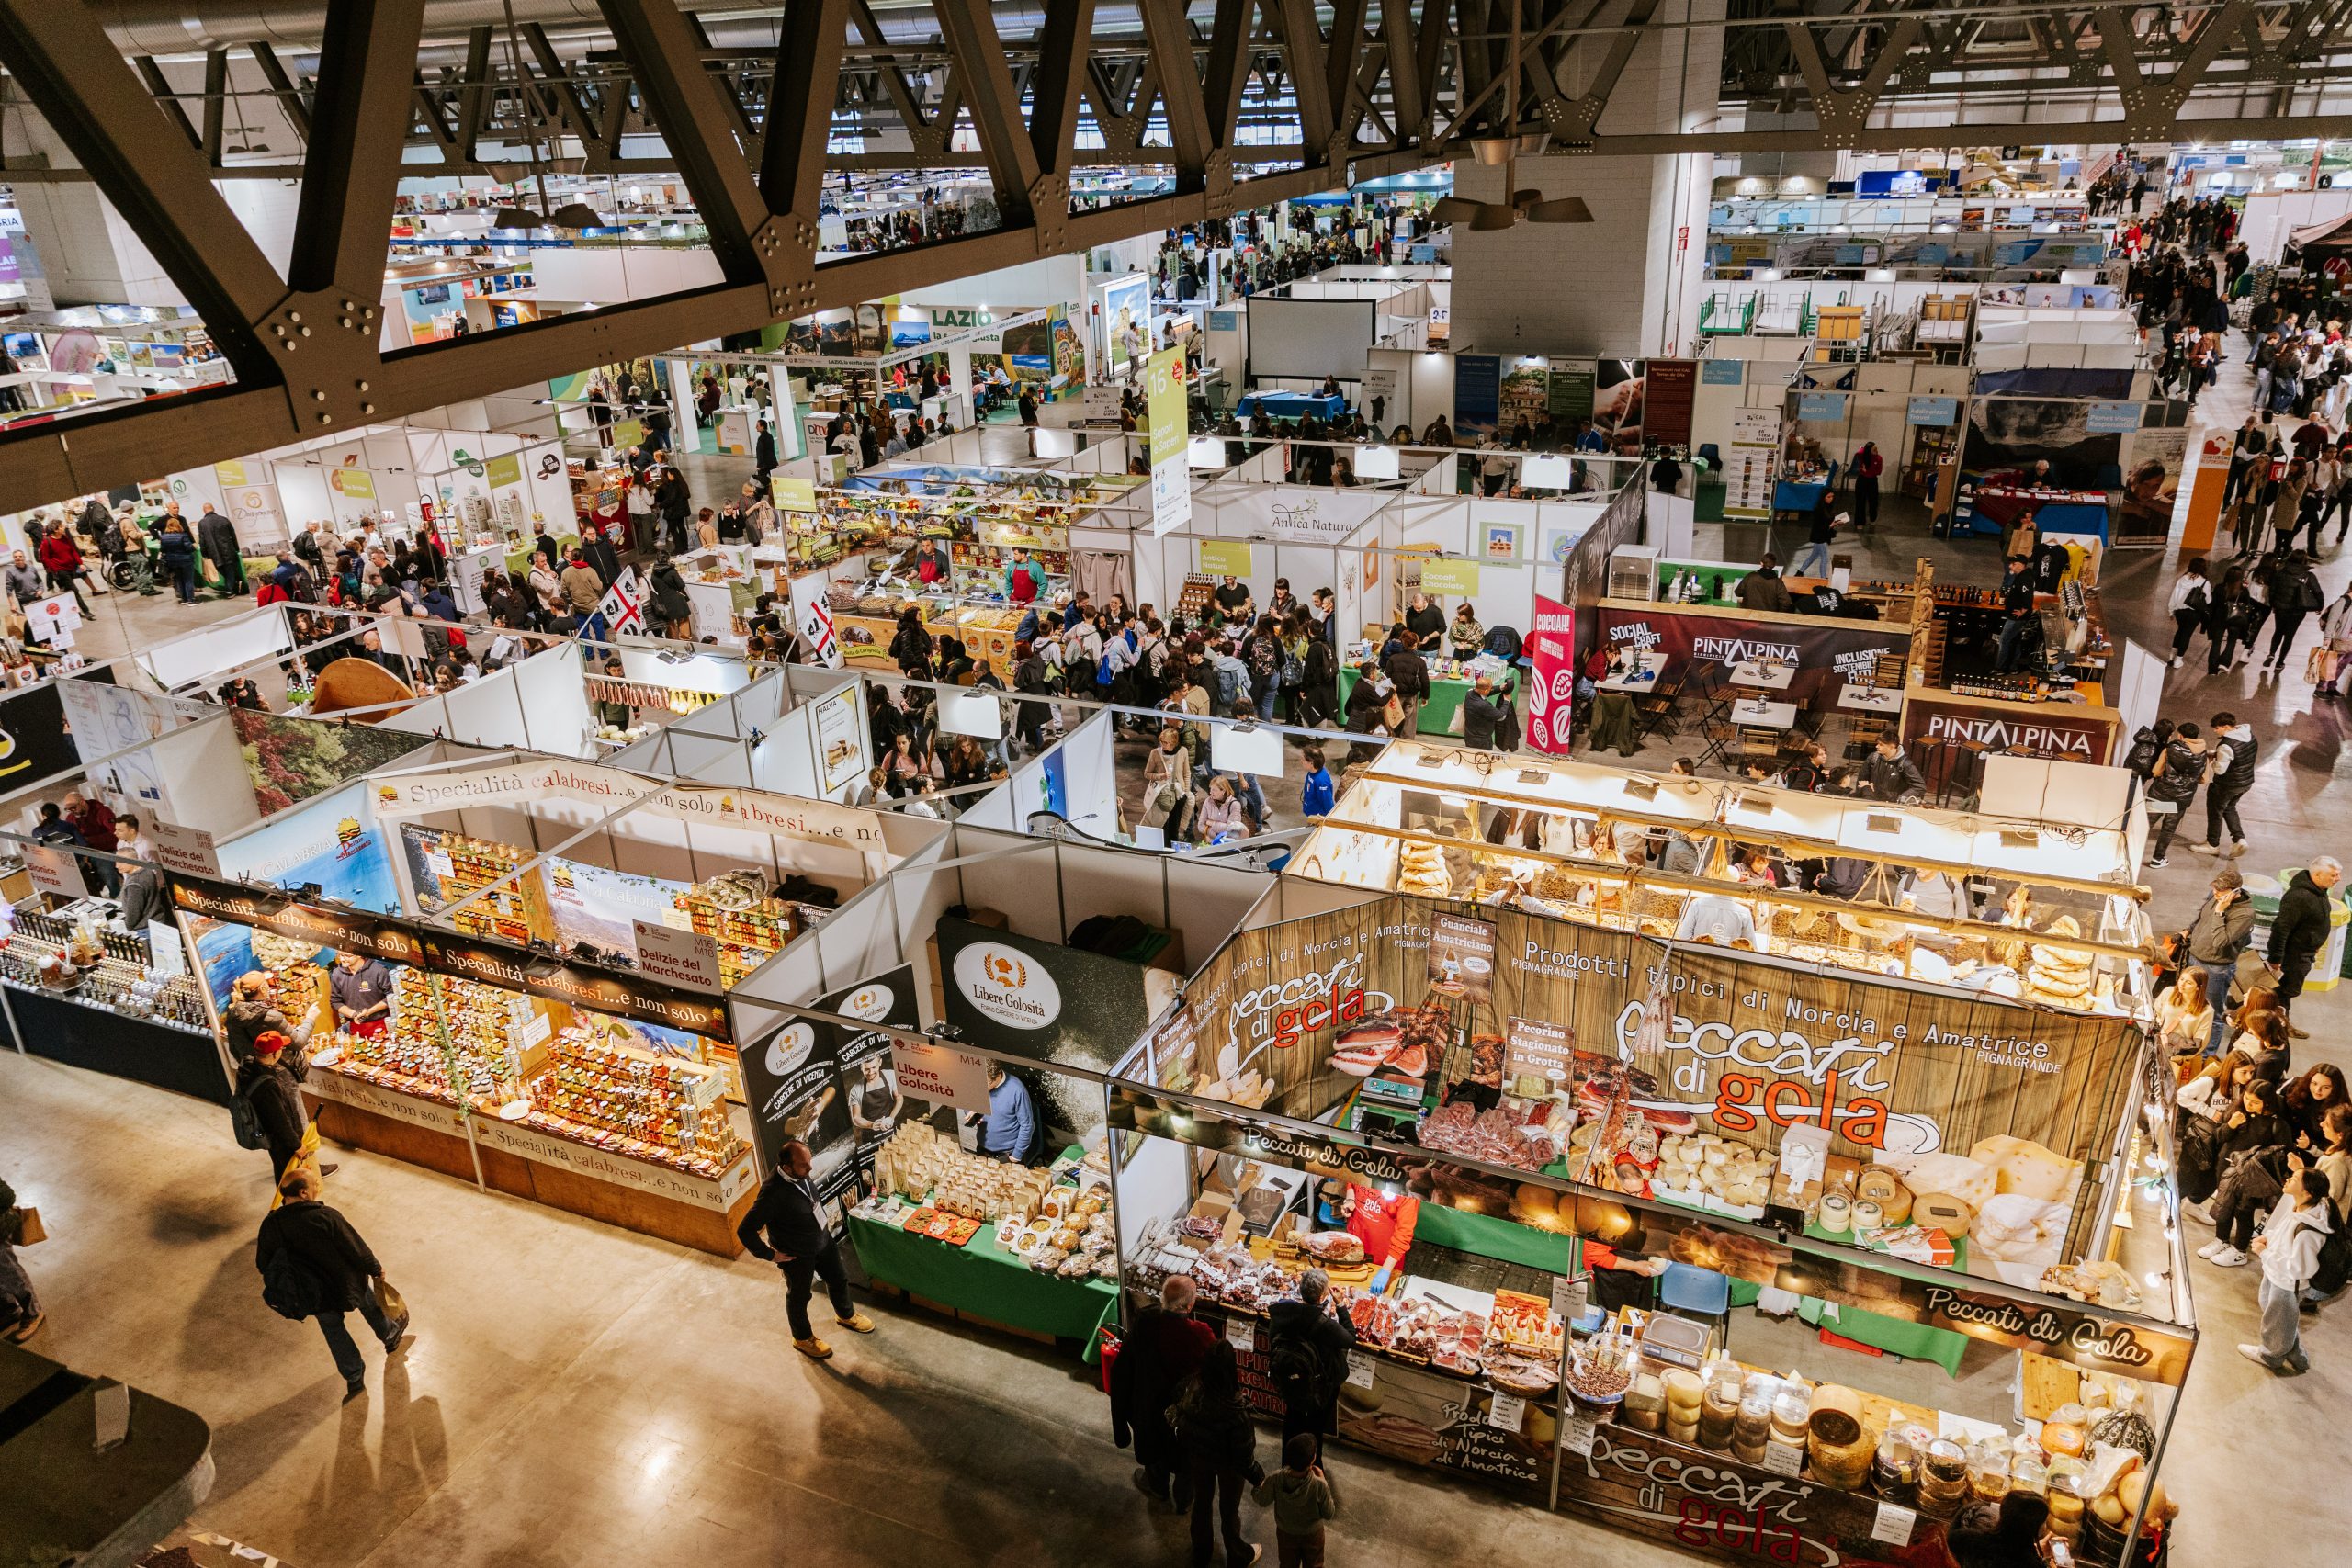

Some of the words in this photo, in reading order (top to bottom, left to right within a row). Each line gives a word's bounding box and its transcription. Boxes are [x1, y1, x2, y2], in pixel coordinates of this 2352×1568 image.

[932, 310, 992, 327] LAZIO
[1151, 368, 1167, 397] 16
[1153, 423, 1173, 441] Sapori
[1312, 519, 1352, 532] Natura
[1202, 554, 1226, 562] Antica
[1203, 562, 1228, 570] Natura
[1423, 573, 1456, 581] Cocoah!
[1424, 581, 1465, 590] Chocolate
[1536, 613, 1570, 632] COCOAH!
[1610, 622, 1652, 641] SOCIAL
[1634, 633, 1661, 647] CRAFT
[1694, 637, 1800, 667] PINTALPINA
[818, 700, 837, 715] HALVA
[1929, 716, 2092, 754] PINTALPINA
[410, 771, 524, 805] Specialità
[677, 795, 713, 815] solo
[158, 843, 187, 859] Delizie
[190, 851, 204, 863] del
[27, 862, 57, 876] Bionice
[162, 855, 215, 875] Marchesato
[31, 873, 62, 886] Firenze
[586, 883, 603, 898] La
[606, 888, 662, 910] Calabria
[187, 890, 259, 919] Specialità
[349, 929, 372, 947] non
[378, 936, 409, 953] solo
[1440, 917, 1488, 937] Guanciale
[694, 936, 714, 949] M16
[695, 945, 715, 958] M18
[1394, 939, 1430, 950] PIGNAGRA
[1432, 931, 1493, 955] Amatriciano
[639, 947, 679, 966] Delizie
[682, 957, 701, 971] del
[1511, 958, 1580, 980] PIGNAGRANDE
[641, 961, 712, 987] Marchesato
[1194, 976, 1230, 1021] Prodotti
[1233, 953, 1271, 981] tipici
[1280, 947, 1294, 963] di
[1304, 935, 1352, 956] Norcia
[1360, 931, 1368, 942] e
[1375, 921, 1430, 938] Amatric
[447, 950, 525, 983] Specialità
[635, 995, 668, 1016] non
[671, 1004, 707, 1024] solo
[973, 983, 1004, 1006] Libere
[1004, 992, 1046, 1018] Golosità
[1229, 951, 1365, 1047] peccati
[1525, 941, 1631, 980] Prodotti
[1647, 964, 1725, 1000] tipici
[1742, 988, 1769, 1012] di
[1785, 999, 1877, 1034] Norcia
[1893, 1021, 1908, 1040] e
[1923, 1022, 2050, 1059] Amatrice
[1251, 1009, 1270, 1040] di
[1272, 985, 1366, 1050] gola
[1157, 1013, 1189, 1046] Formaggio
[1516, 1020, 1566, 1041] Pecorino
[1162, 1039, 1180, 1060] capra
[1179, 1025, 1194, 1043] 100%
[1510, 1034, 1569, 1057] Stagionato
[1615, 998, 1895, 1093] peccati
[775, 1055, 790, 1070] Libere
[897, 1061, 939, 1081] Libere
[960, 1055, 982, 1067] M14
[1513, 1051, 1525, 1063] in
[1527, 1052, 1565, 1070] Grotta
[1976, 1050, 2061, 1074] PIGNAGRANDE
[773, 1086, 797, 1110] CARCERE
[802, 1068, 825, 1087] VICENZA
[899, 1076, 955, 1098] Golosità
[392, 1100, 418, 1118] non
[420, 1106, 447, 1126] solo
[1672, 1056, 1707, 1094] di
[1712, 1069, 1889, 1152] gola
[495, 1128, 570, 1163] Specialità
[671, 1180, 700, 1200] non
[1243, 1126, 1316, 1163] Peccati
[1320, 1145, 1344, 1166] di
[1350, 1151, 1402, 1181] Gola
[1363, 1197, 1382, 1214] gola
[1926, 1288, 2024, 1333] Peccati
[2030, 1311, 2062, 1341] di
[2070, 1320, 2149, 1366] Gola
[1459, 1423, 1506, 1445] Tipici
[1431, 1434, 1449, 1449] di
[1455, 1436, 1520, 1463] Norcia
[1525, 1455, 1538, 1467] e
[1436, 1450, 1453, 1466] di
[1458, 1451, 1540, 1482] Amatrice
[1587, 1433, 1814, 1524] peccati
[1638, 1483, 1663, 1514] di
[1675, 1497, 1801, 1562] gola
